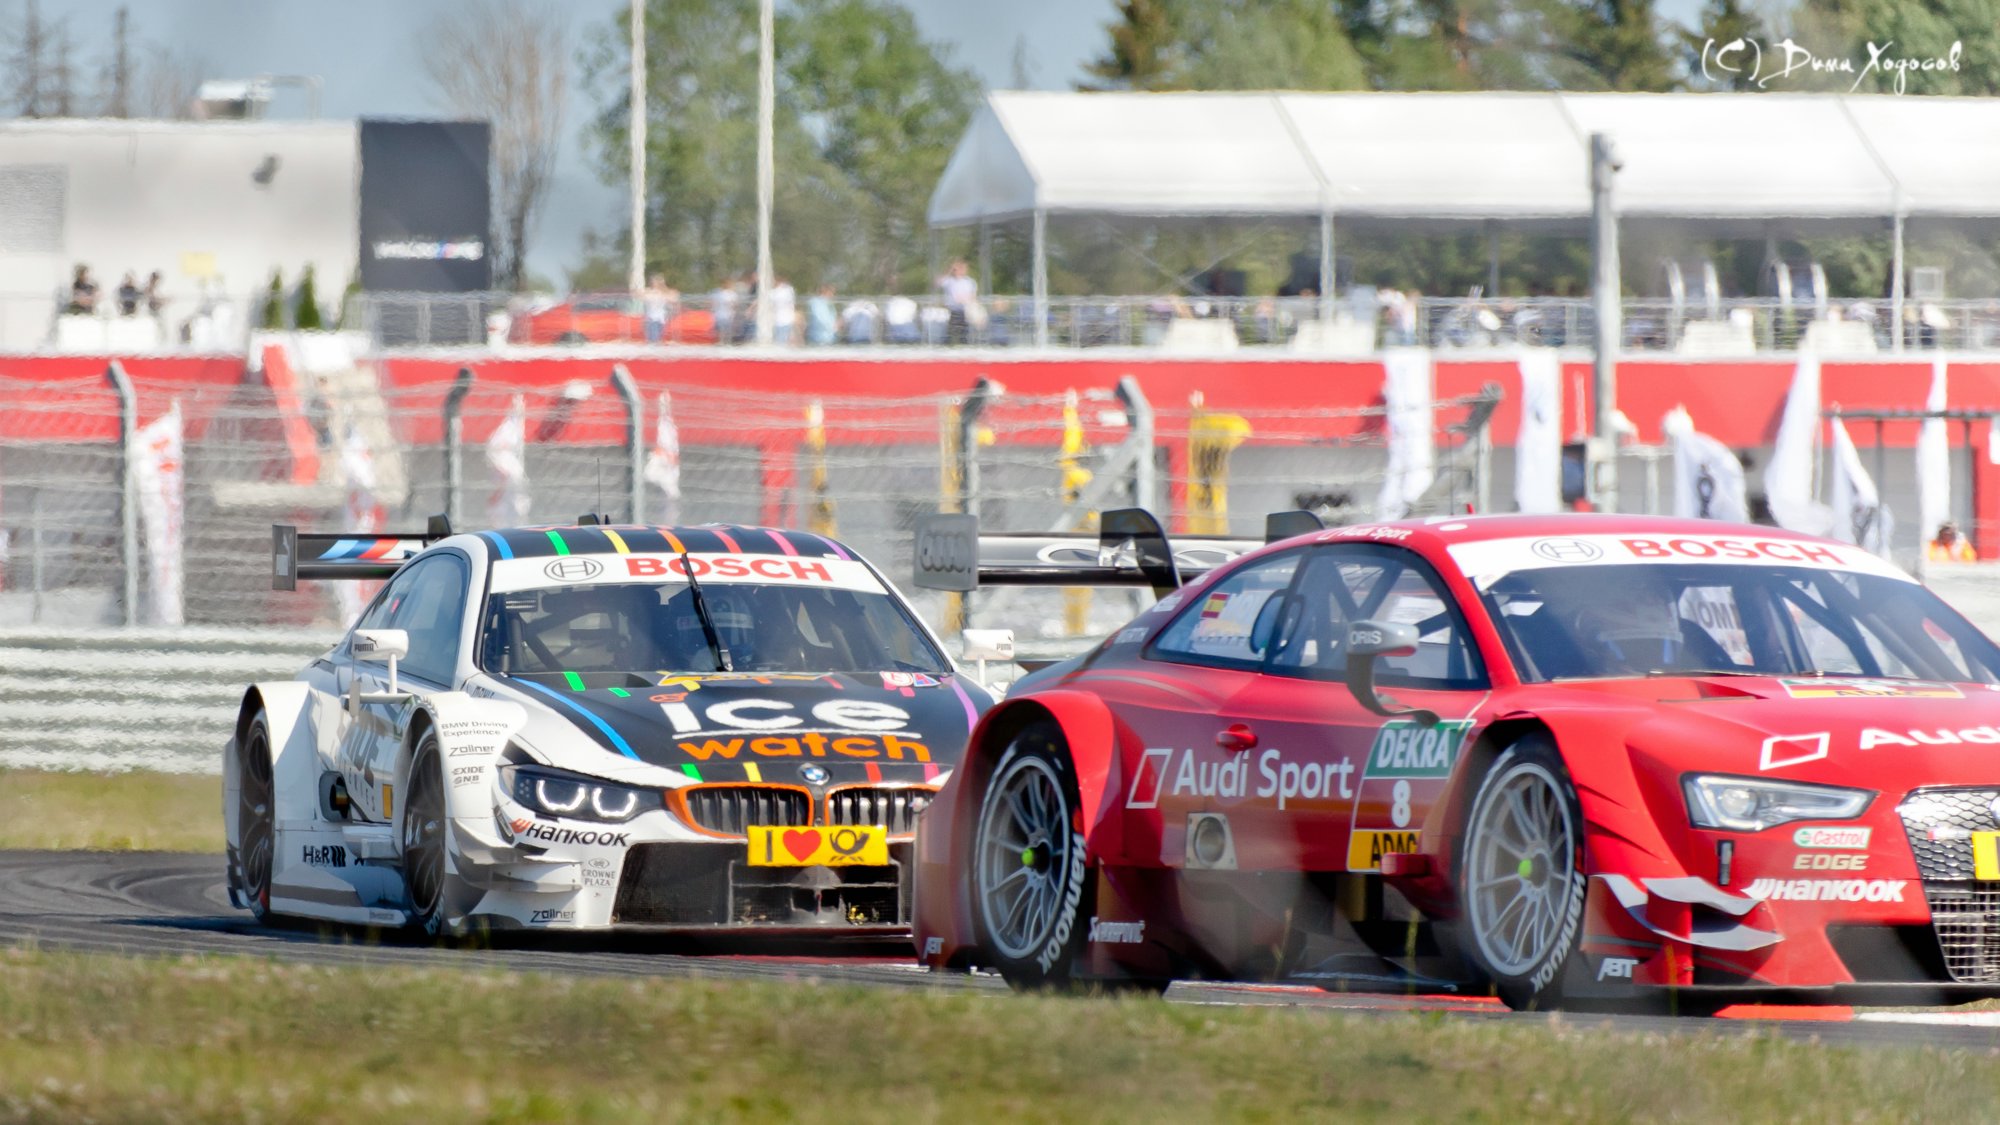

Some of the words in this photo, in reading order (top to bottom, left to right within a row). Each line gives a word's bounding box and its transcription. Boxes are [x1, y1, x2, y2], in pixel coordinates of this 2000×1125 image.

[1620, 539, 1846, 565] BOSCH
[625, 557, 834, 582] BOSCH
[1351, 631, 1383, 645] ORIS
[441, 721, 469, 730] BMW
[471, 720, 508, 730] Driving
[661, 699, 911, 734] ice
[443, 729, 501, 738] Experience
[1859, 726, 2000, 750] Aud
[678, 732, 932, 763] watch
[1376, 728, 1450, 768] DEKRA
[1172, 749, 1249, 797] Audi
[1256, 749, 1355, 811] Sport
[1391, 780, 1412, 828] 8
[1810, 829, 1865, 847] Castrol
[581, 869, 616, 879] CROWNE
[1793, 854, 1870, 870] EDGE
[584, 877, 611, 887] PLAZA
[1597, 957, 1640, 982] ABT
